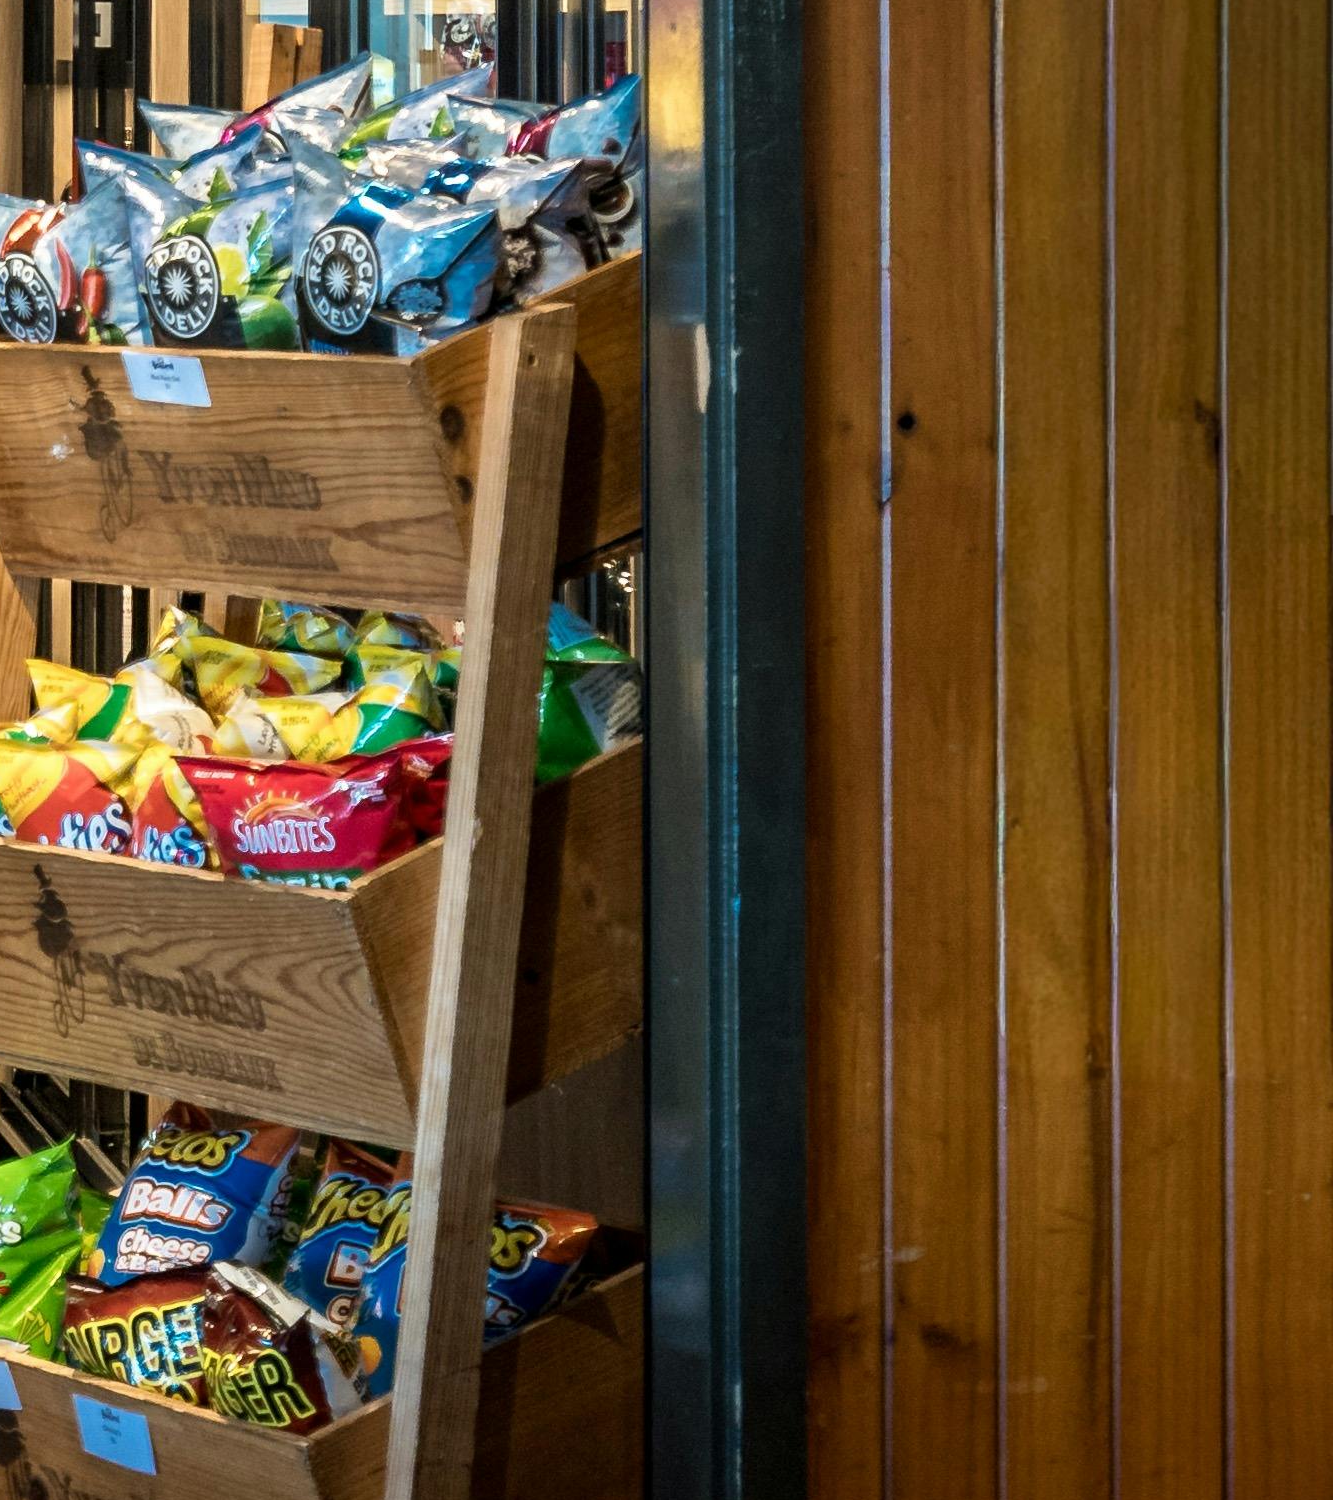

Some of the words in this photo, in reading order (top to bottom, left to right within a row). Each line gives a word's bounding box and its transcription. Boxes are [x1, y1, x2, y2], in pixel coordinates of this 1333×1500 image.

[12, 258, 51, 312] ROCK
[309, 234, 337, 282] RED
[340, 233, 373, 300] ROCK
[162, 307, 206, 331] DELI
[317, 295, 359, 328] DELI
[233, 815, 336, 855] SUNBITES
[122, 1175, 234, 1232] Balls
[118, 1225, 214, 1265] Cheese
